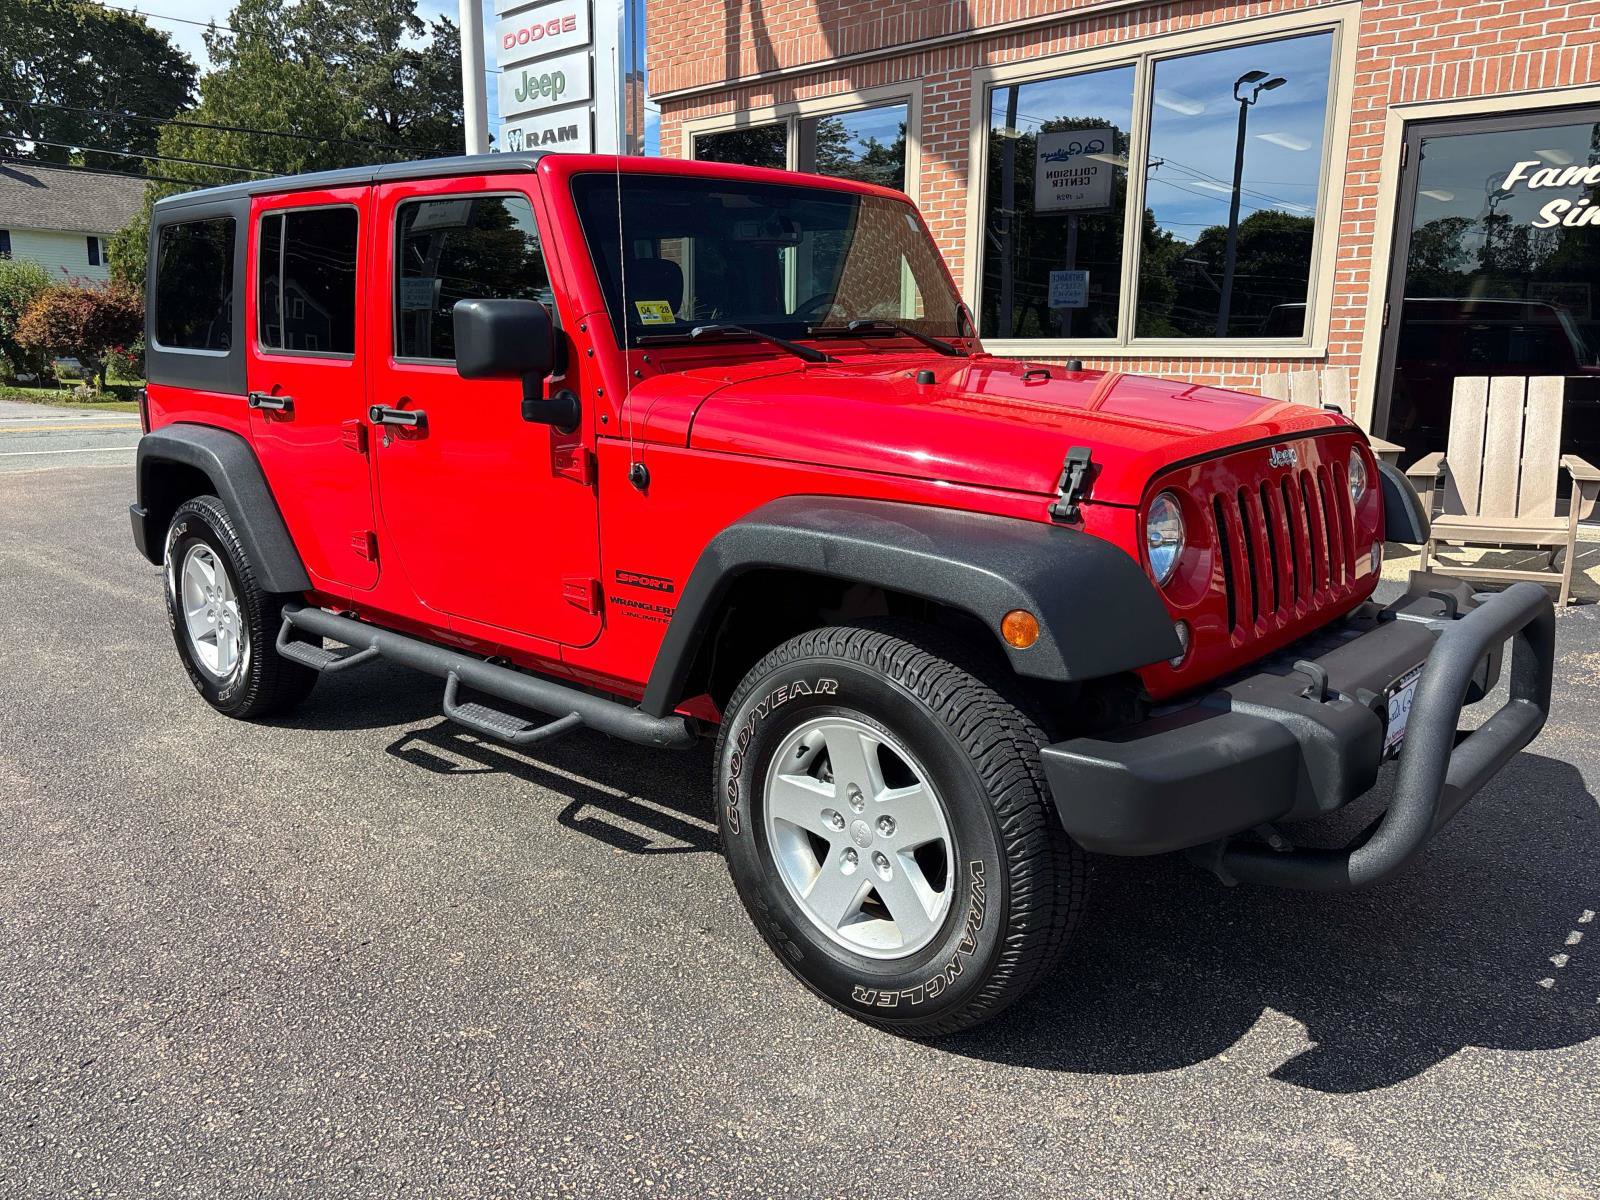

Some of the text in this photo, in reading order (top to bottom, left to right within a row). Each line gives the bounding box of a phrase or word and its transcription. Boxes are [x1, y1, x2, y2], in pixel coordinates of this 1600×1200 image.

[503, 15, 577, 50] DODGE
[514, 70, 566, 103] Jeep
[525, 124, 578, 149] RAM
[1269, 447, 1297, 467] Jeep
[618, 573, 672, 589] SPORT
[610, 595, 674, 616] WRANGLER
[727, 679, 839, 835] GOODYEAR
[851, 860, 987, 1008] WRANGLER
